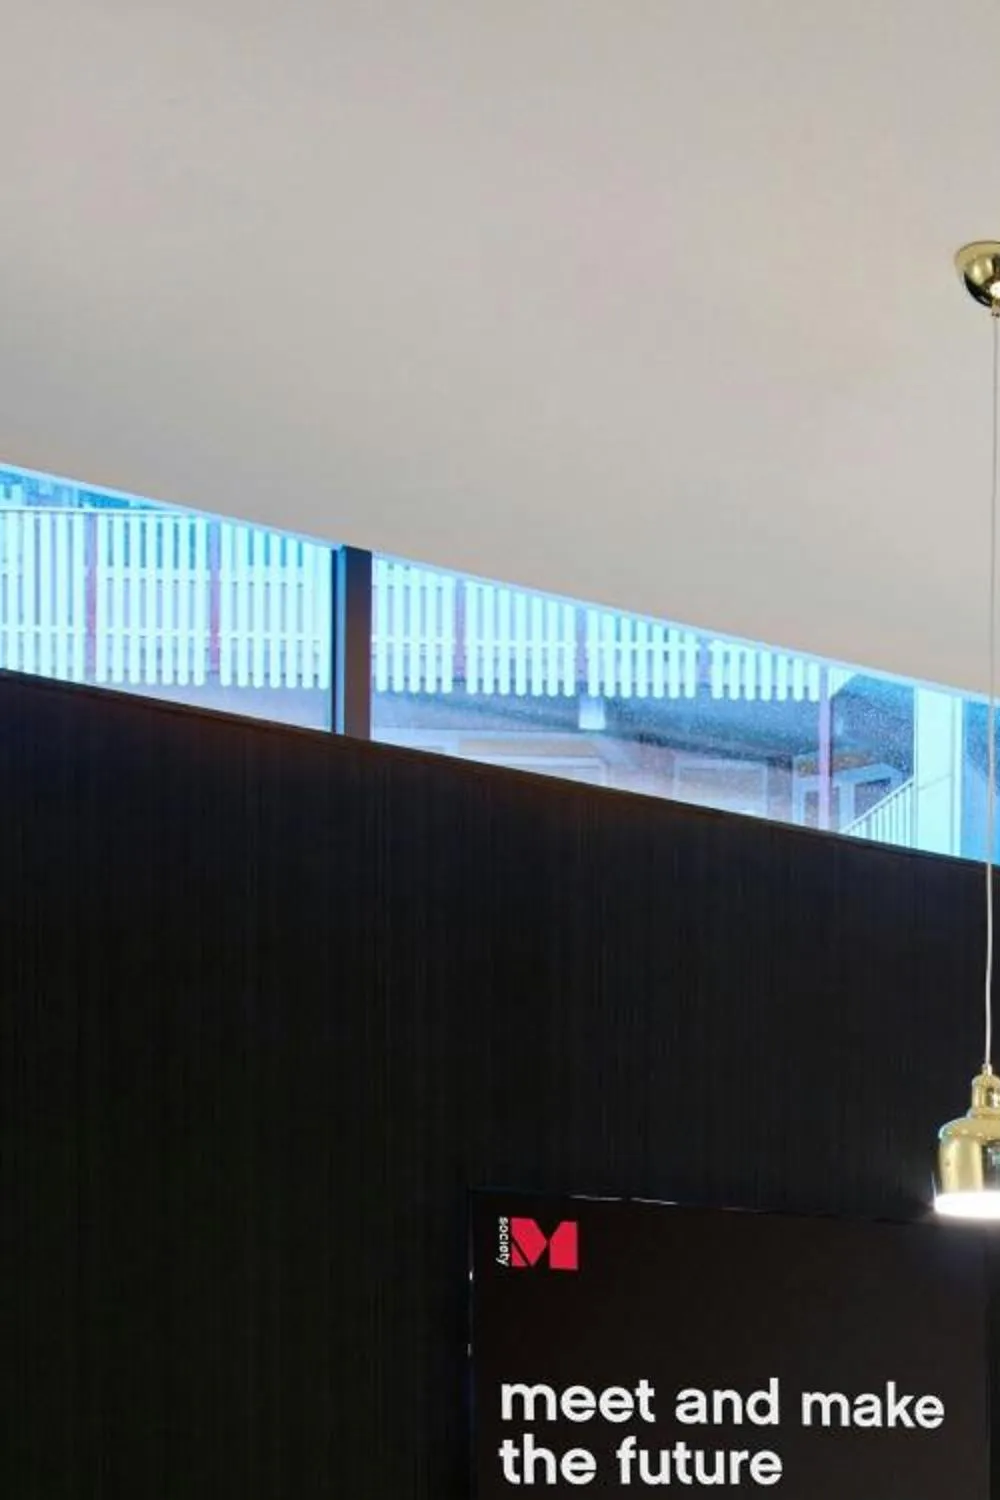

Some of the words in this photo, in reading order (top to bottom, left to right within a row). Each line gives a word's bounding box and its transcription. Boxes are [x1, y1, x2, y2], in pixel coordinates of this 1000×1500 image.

[495, 1216, 509, 1267] society
[501, 1379, 656, 1423] meet
[675, 1377, 780, 1426] and
[801, 1381, 945, 1429] make
[498, 1433, 597, 1486] the
[615, 1435, 783, 1487] future
